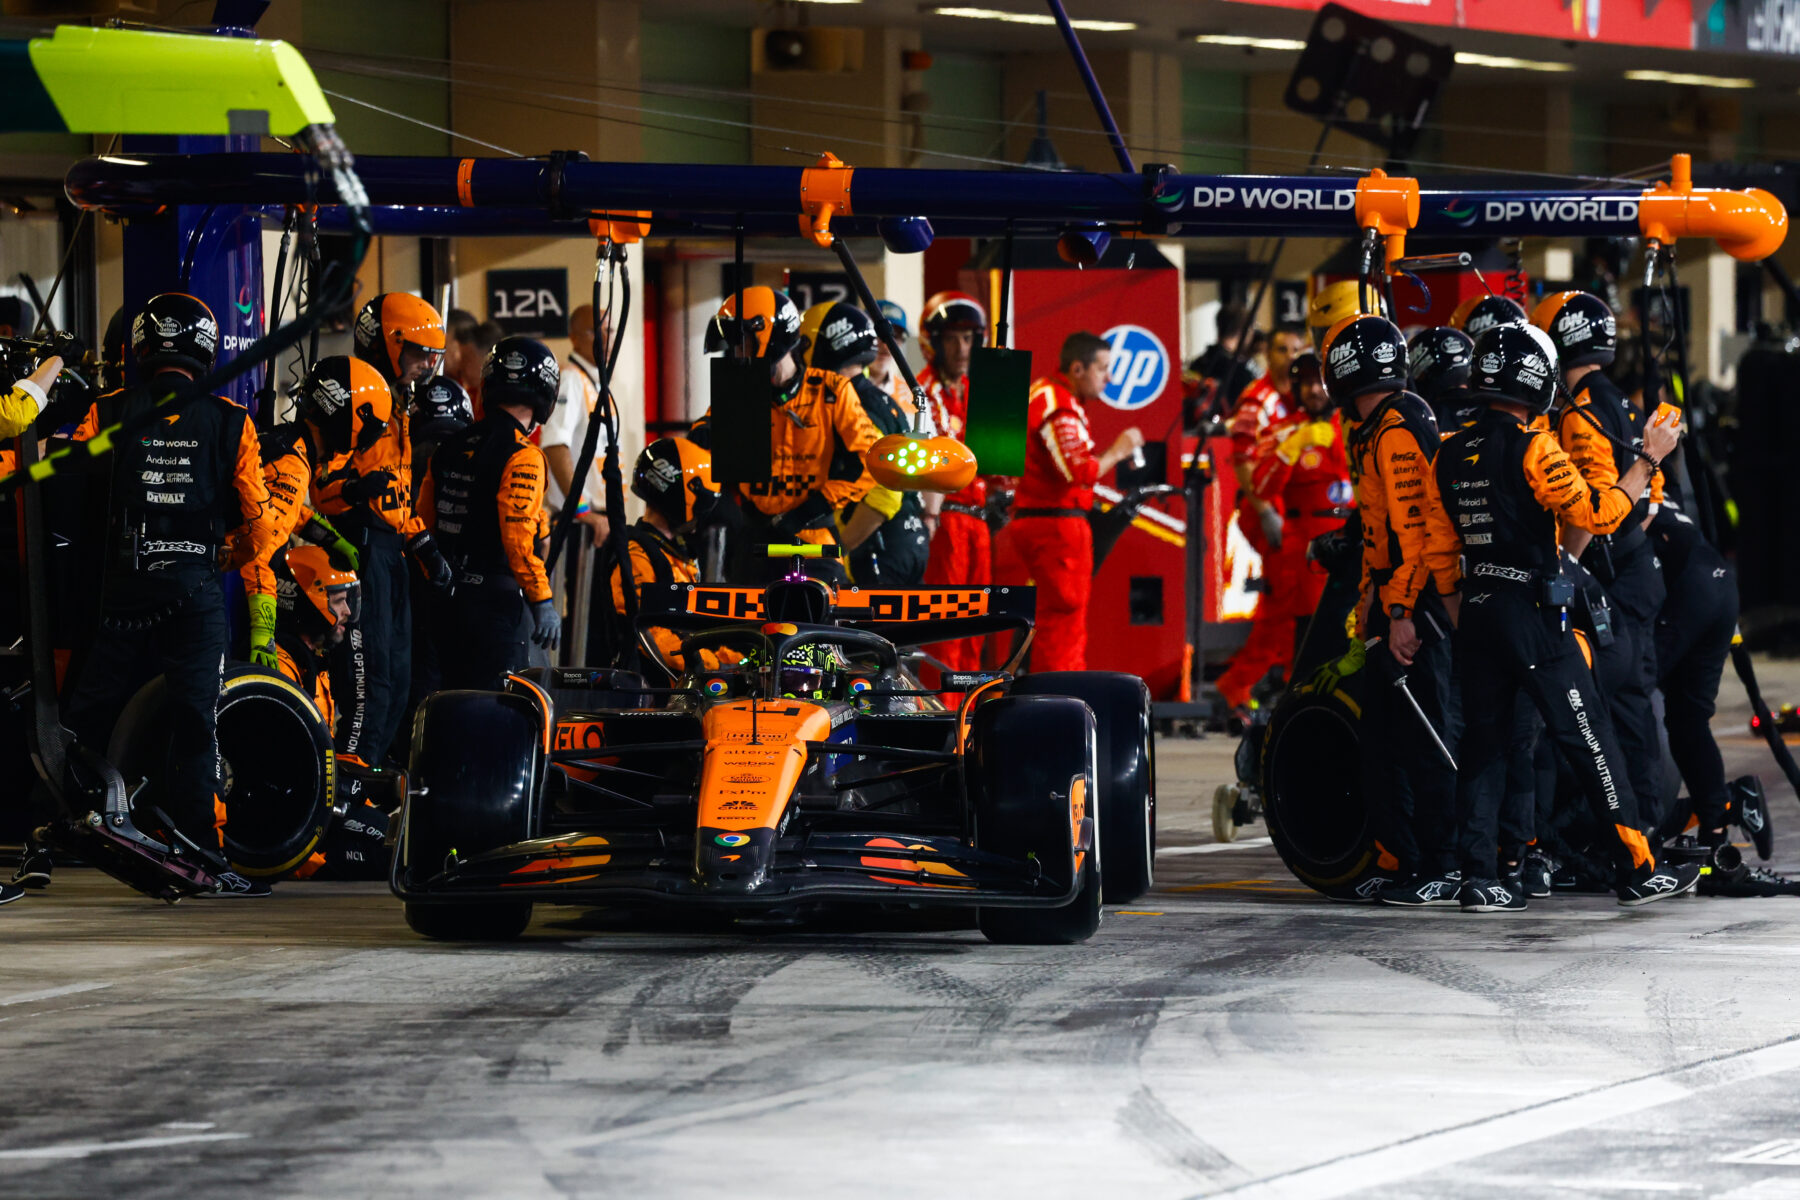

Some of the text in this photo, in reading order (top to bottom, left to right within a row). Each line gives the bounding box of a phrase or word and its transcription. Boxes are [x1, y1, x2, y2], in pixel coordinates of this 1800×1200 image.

[1193, 187, 1356, 211] DP WORLD
[1485, 201, 1639, 222] DP WORLD
[494, 289, 563, 318] 12A
[826, 317, 854, 341] ON
[1469, 312, 1499, 333] ON
[1558, 310, 1590, 334] ON
[223, 335, 238, 350] DP
[1330, 341, 1357, 366] ON
[1110, 329, 1160, 406] hp
[1521, 353, 1549, 377] ON
[319, 378, 351, 407] ON
[153, 439, 198, 448] DP WORLD
[146, 454, 177, 466] Android
[141, 470, 166, 485] ON
[869, 593, 981, 621] OKX
[353, 652, 365, 700] OPTIMUM
[346, 702, 365, 754] NUTRITION
[1567, 687, 1620, 812] ON OPTIMUM NUTRITION
